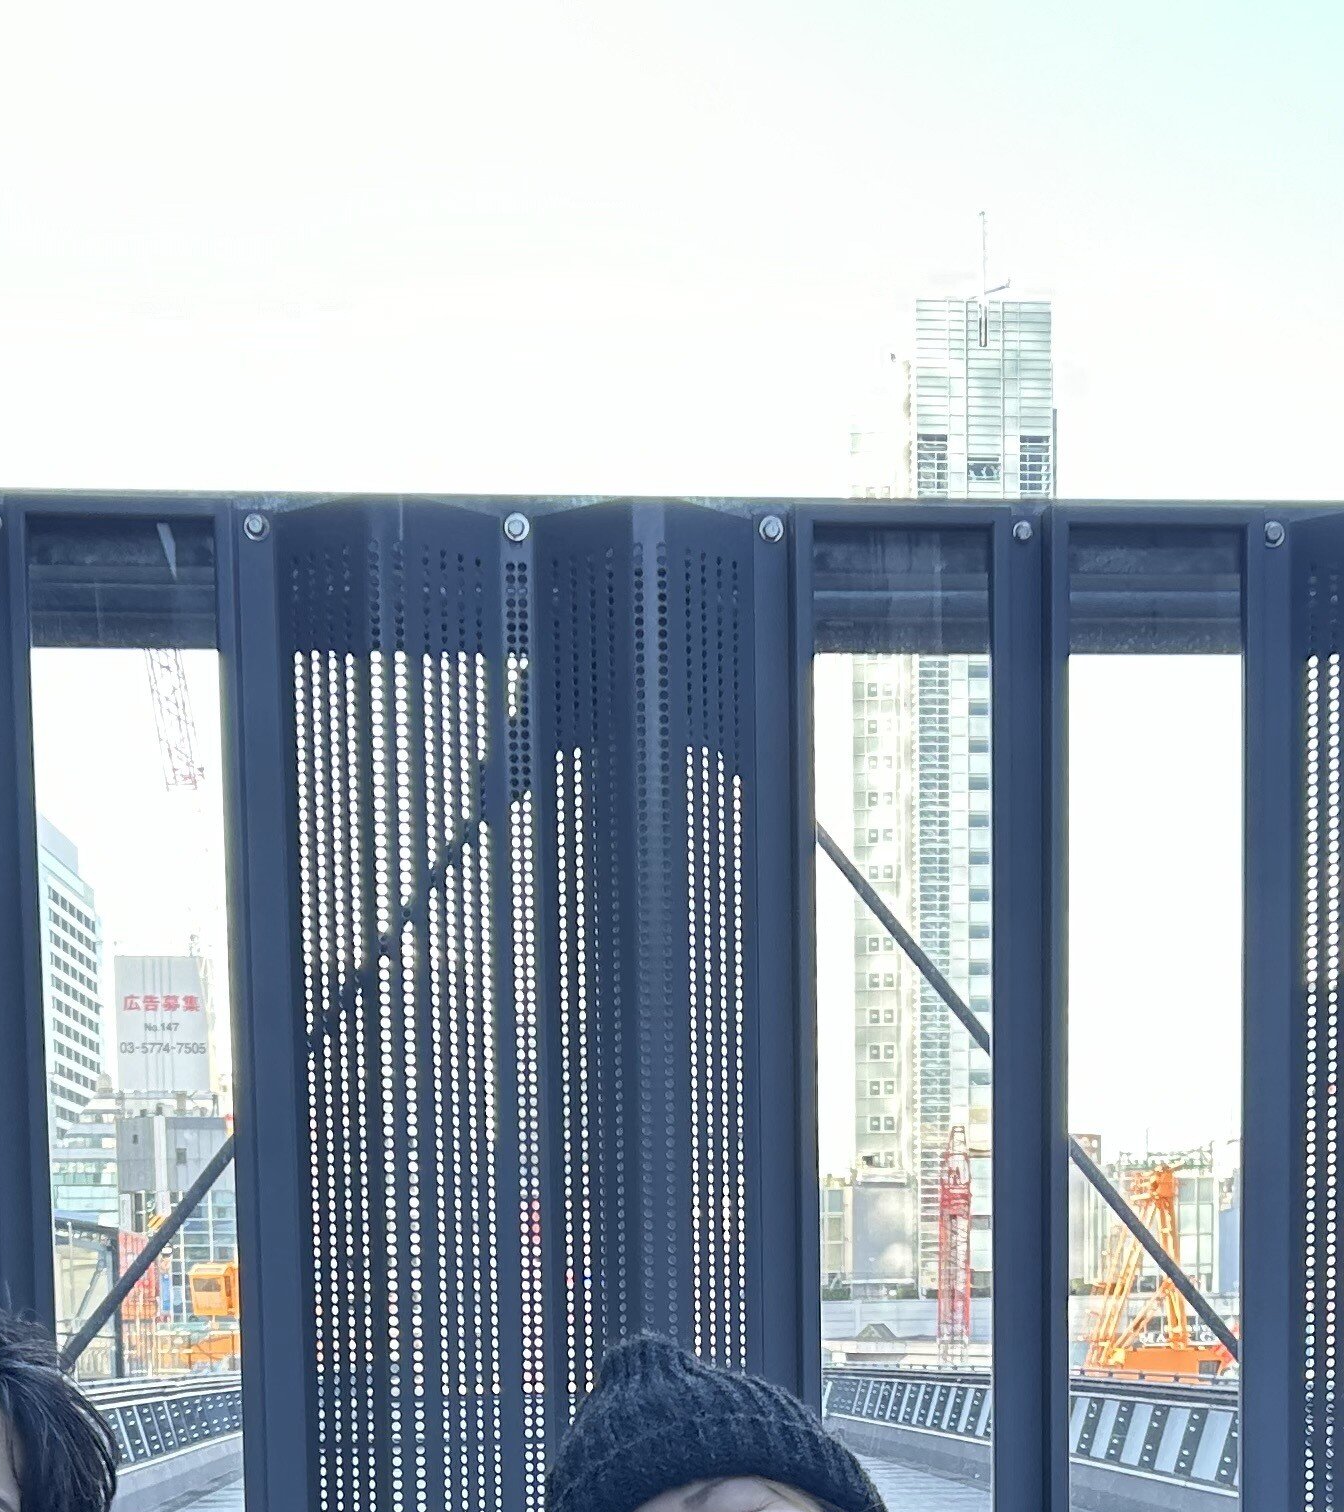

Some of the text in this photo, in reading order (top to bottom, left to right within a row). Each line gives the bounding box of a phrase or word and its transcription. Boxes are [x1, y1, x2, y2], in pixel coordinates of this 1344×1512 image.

[122, 994, 201, 1013] 広告募集
[144, 1022, 180, 1033] No.147
[119, 1041, 207, 1055] 03-5774-7505
